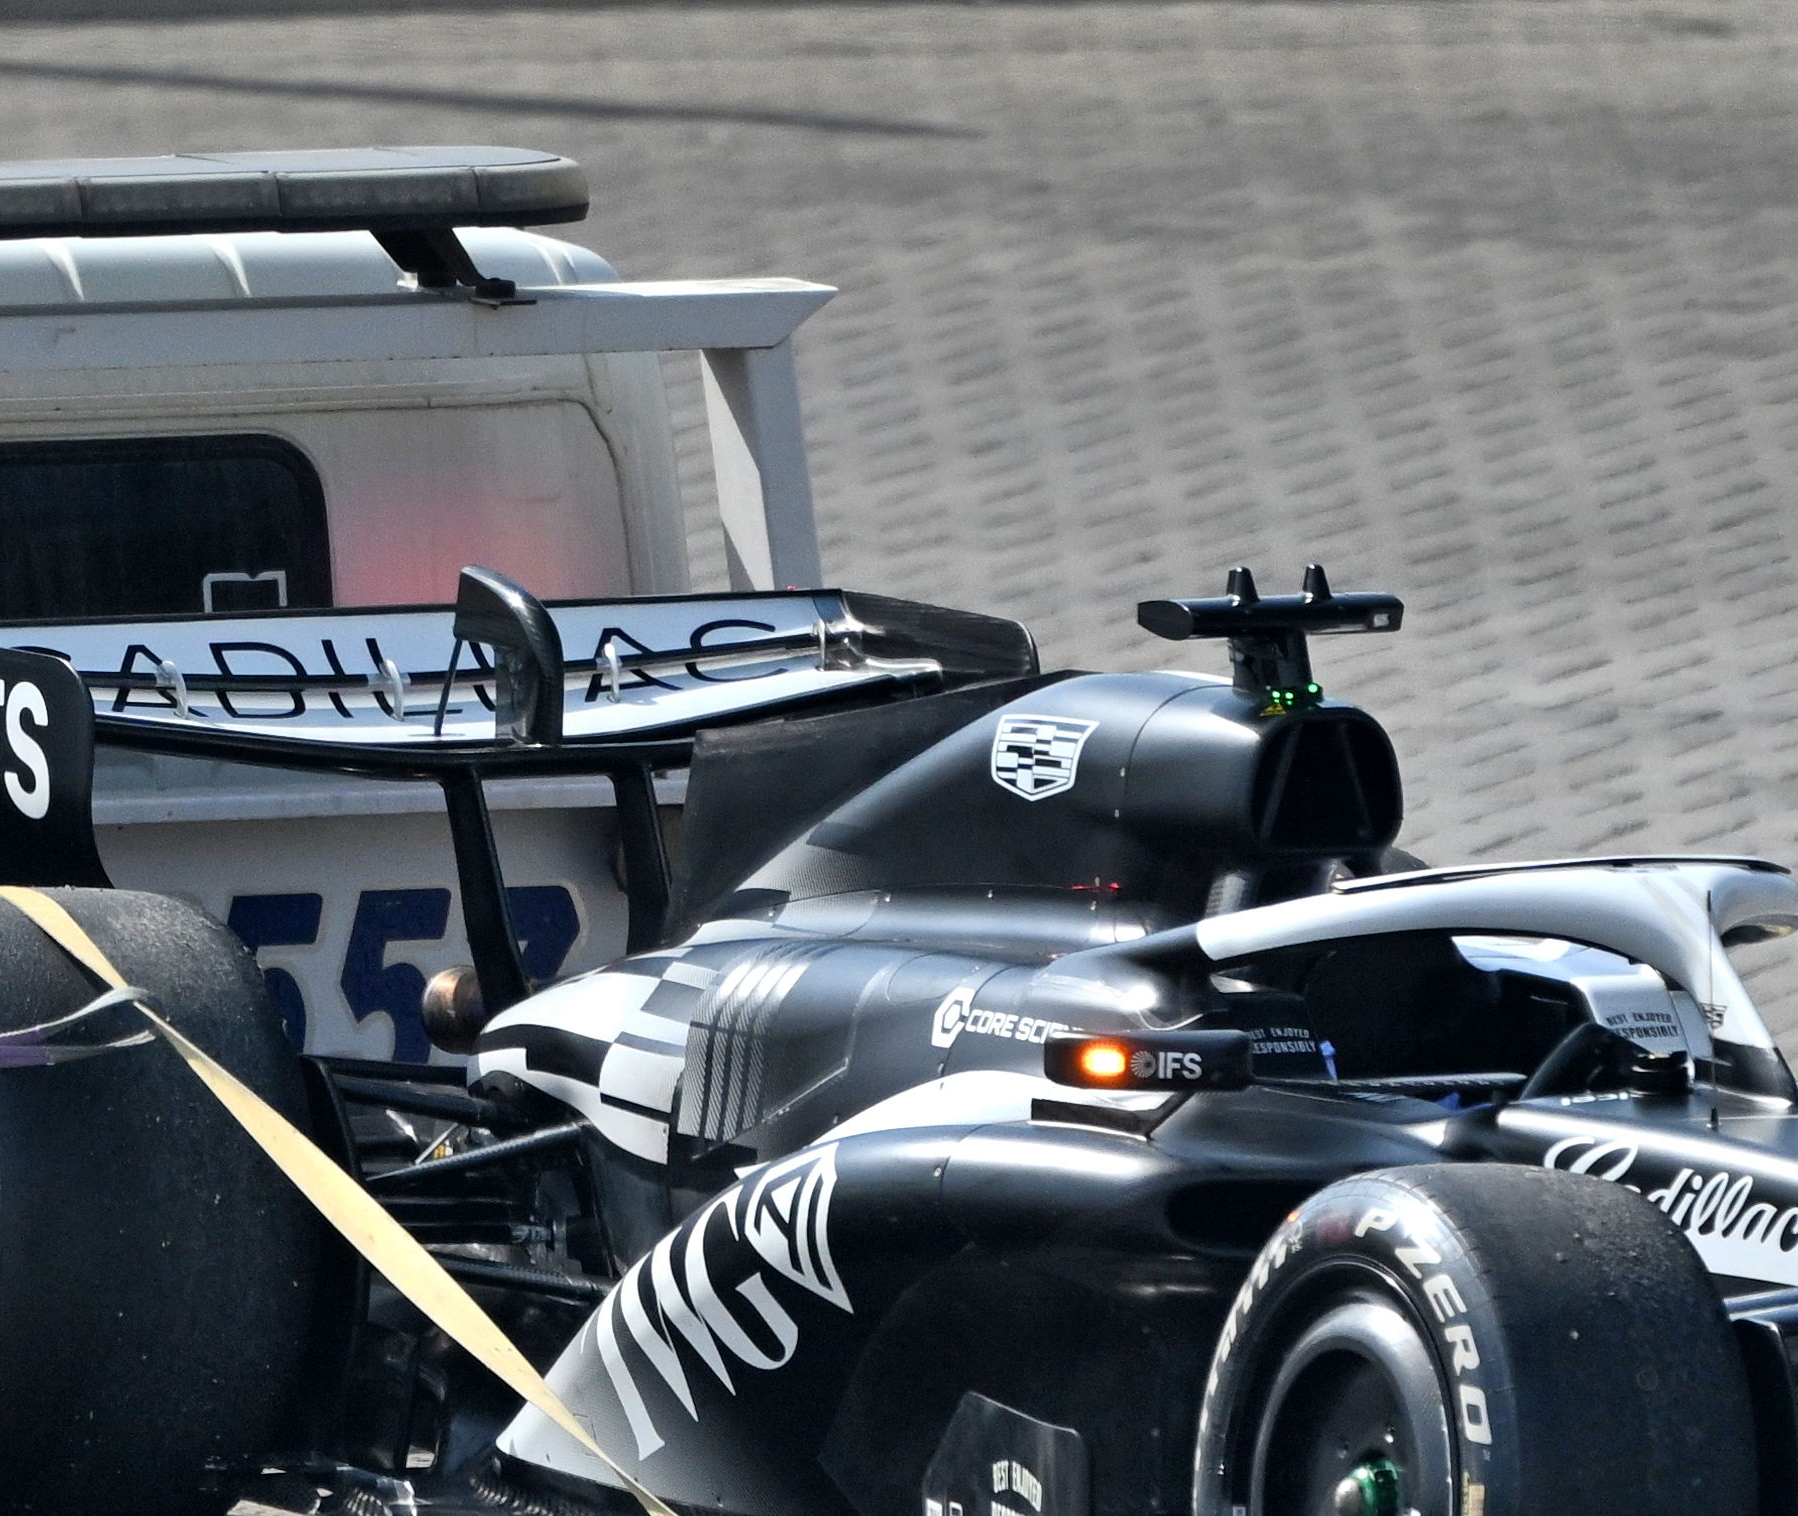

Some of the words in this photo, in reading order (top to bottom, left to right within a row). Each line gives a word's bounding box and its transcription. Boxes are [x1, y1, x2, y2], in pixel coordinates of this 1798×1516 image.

[966, 1009, 1017, 1037] CORE
[1253, 1041, 1316, 1054] ESPONSIBLY
[1158, 1051, 1202, 1079] IFS
[1354, 1208, 1399, 1238] P
[1395, 1234, 1493, 1446] ZERO
